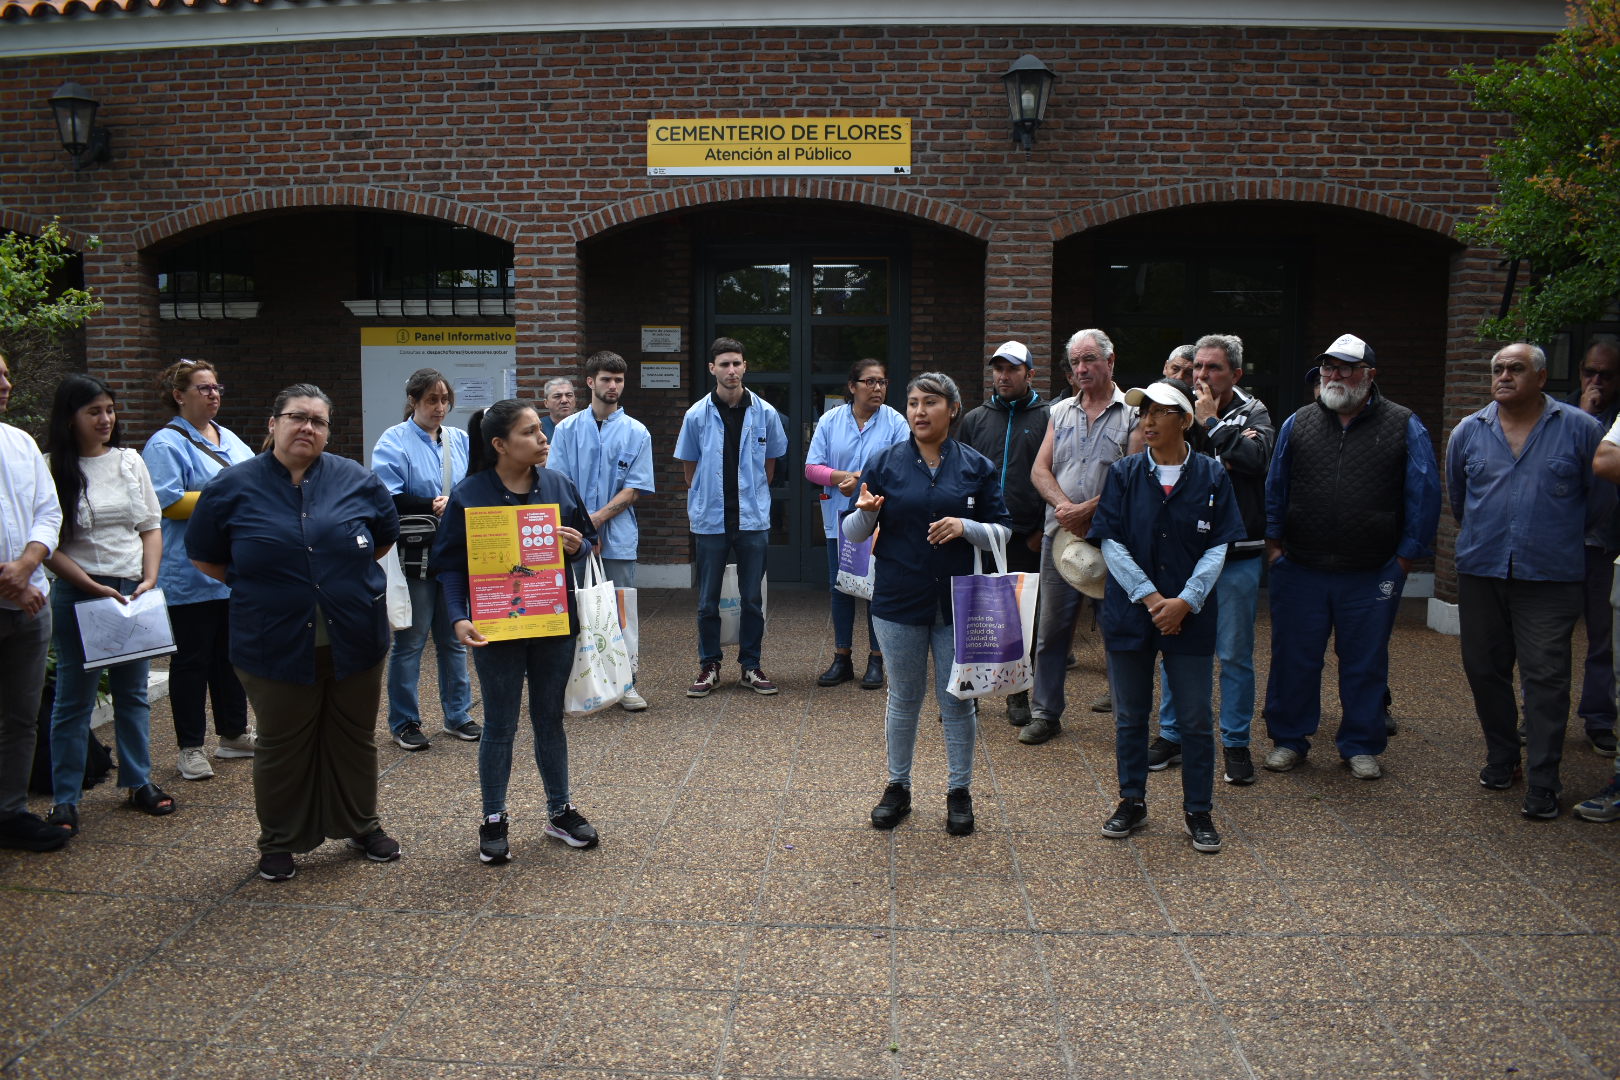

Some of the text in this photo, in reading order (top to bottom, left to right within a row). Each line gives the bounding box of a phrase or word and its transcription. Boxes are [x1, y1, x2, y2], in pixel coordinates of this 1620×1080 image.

[655, 124, 903, 142] CEMENTERIO DE FLORES
[705, 147, 852, 161] Atención al Público
[414, 332, 512, 341] Panel Informativo
